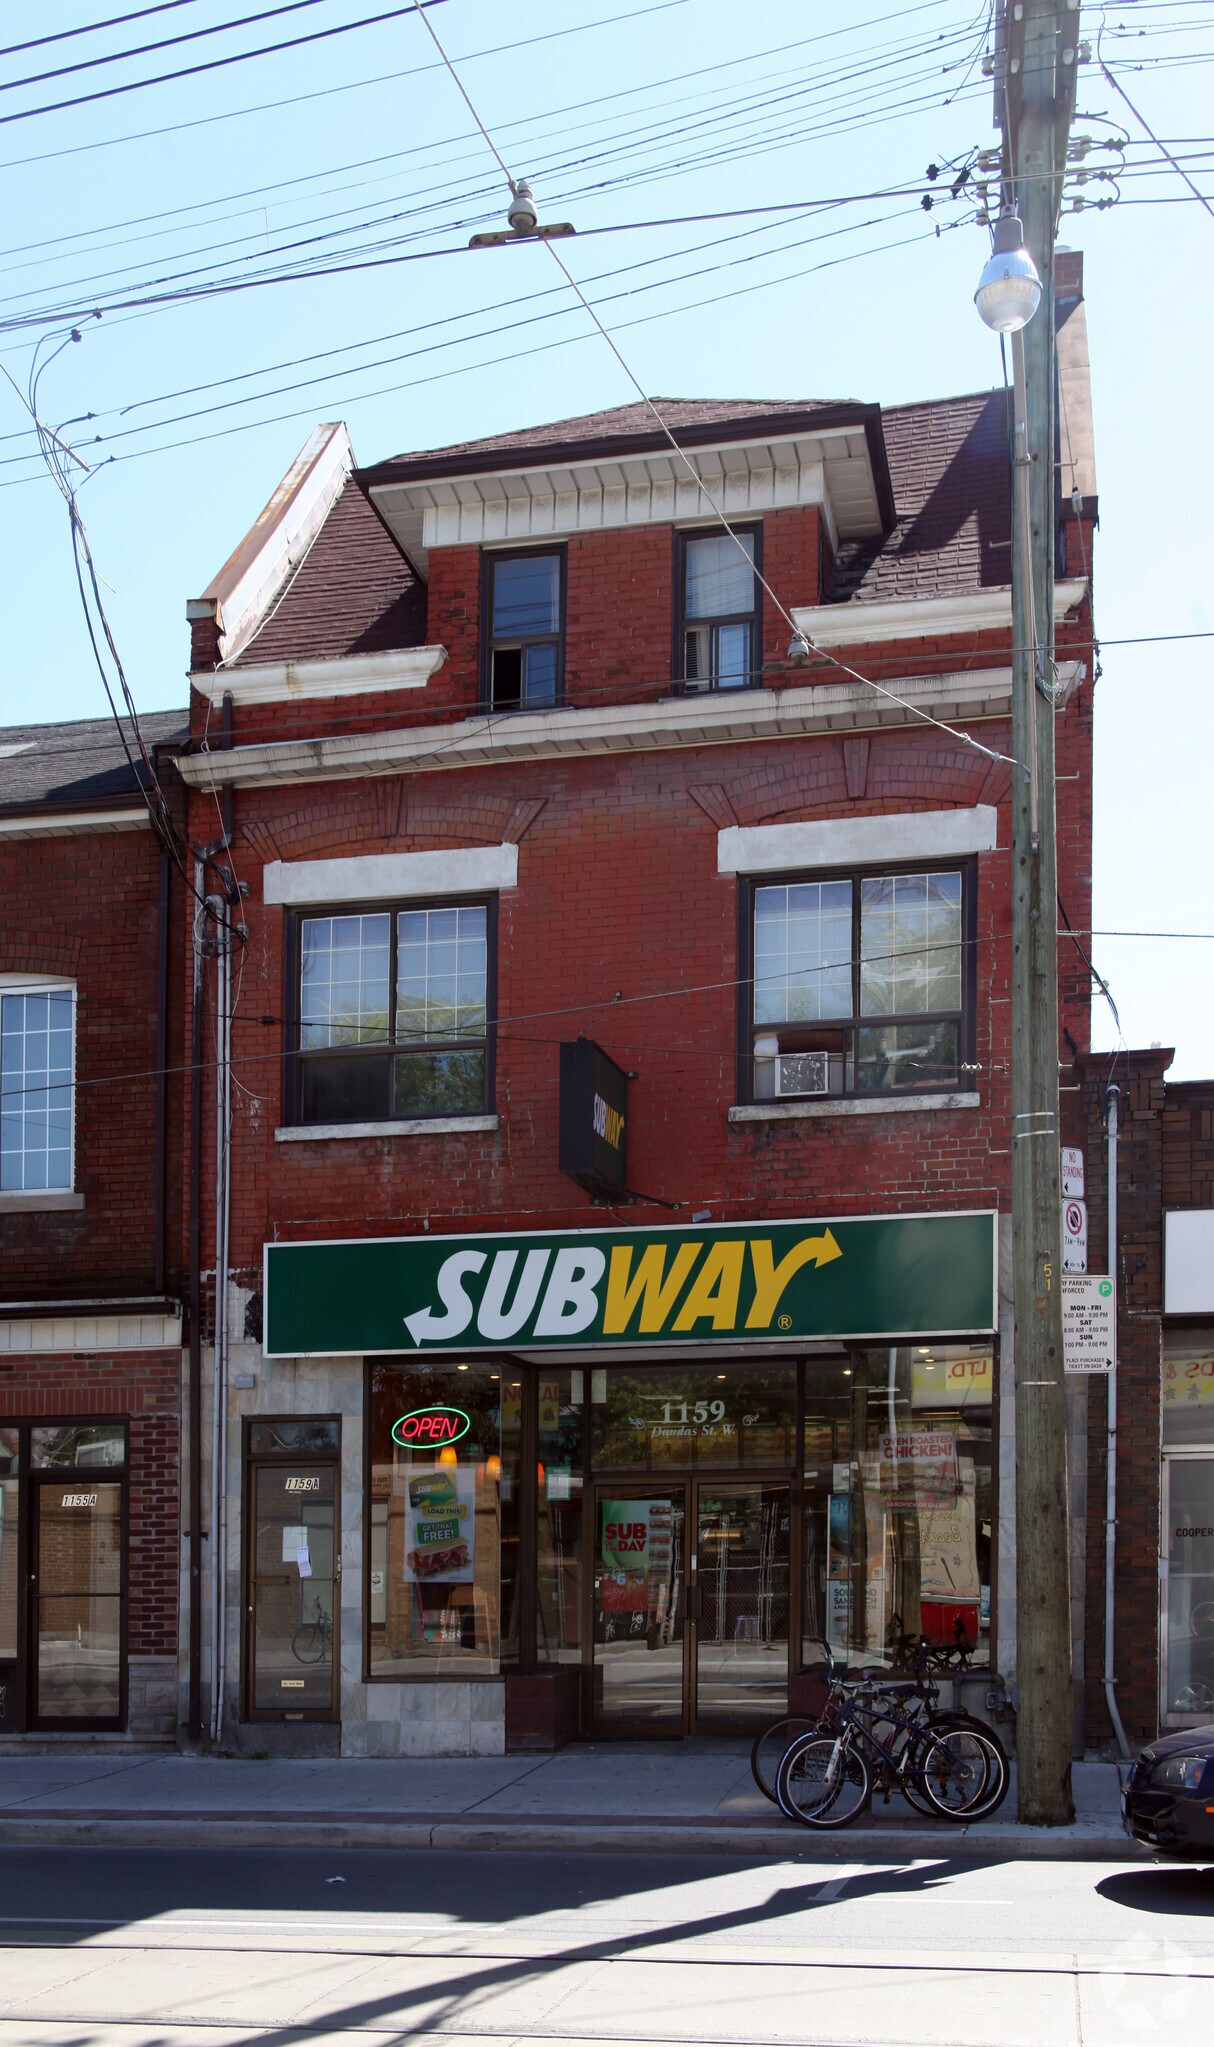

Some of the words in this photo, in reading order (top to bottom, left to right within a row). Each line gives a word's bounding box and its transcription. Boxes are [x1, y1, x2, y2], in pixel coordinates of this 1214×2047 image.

[593, 1093, 625, 1150] SUBWAY
[1068, 1152, 1076, 1163] NO
[1063, 1166, 1083, 1178] STANDING
[403, 1227, 843, 1348] SUBWAY
[661, 1401, 725, 1423] 1159
[401, 1417, 459, 1438] OPEN
[652, 1425, 697, 1437] Dundas
[701, 1424, 716, 1436] St.
[723, 1424, 736, 1435] W.
[883, 1436, 908, 1447] OVEN
[910, 1435, 953, 1445] ROASTED
[883, 1444, 952, 1459] CHICKEN!
[288, 1478, 319, 1489] 1159A
[416, 1482, 448, 1494] SUBWAY
[64, 1495, 96, 1506] 1155A
[424, 1529, 455, 1543] FREE!
[605, 1522, 647, 1540] SUB
[618, 1540, 647, 1552] DAY
